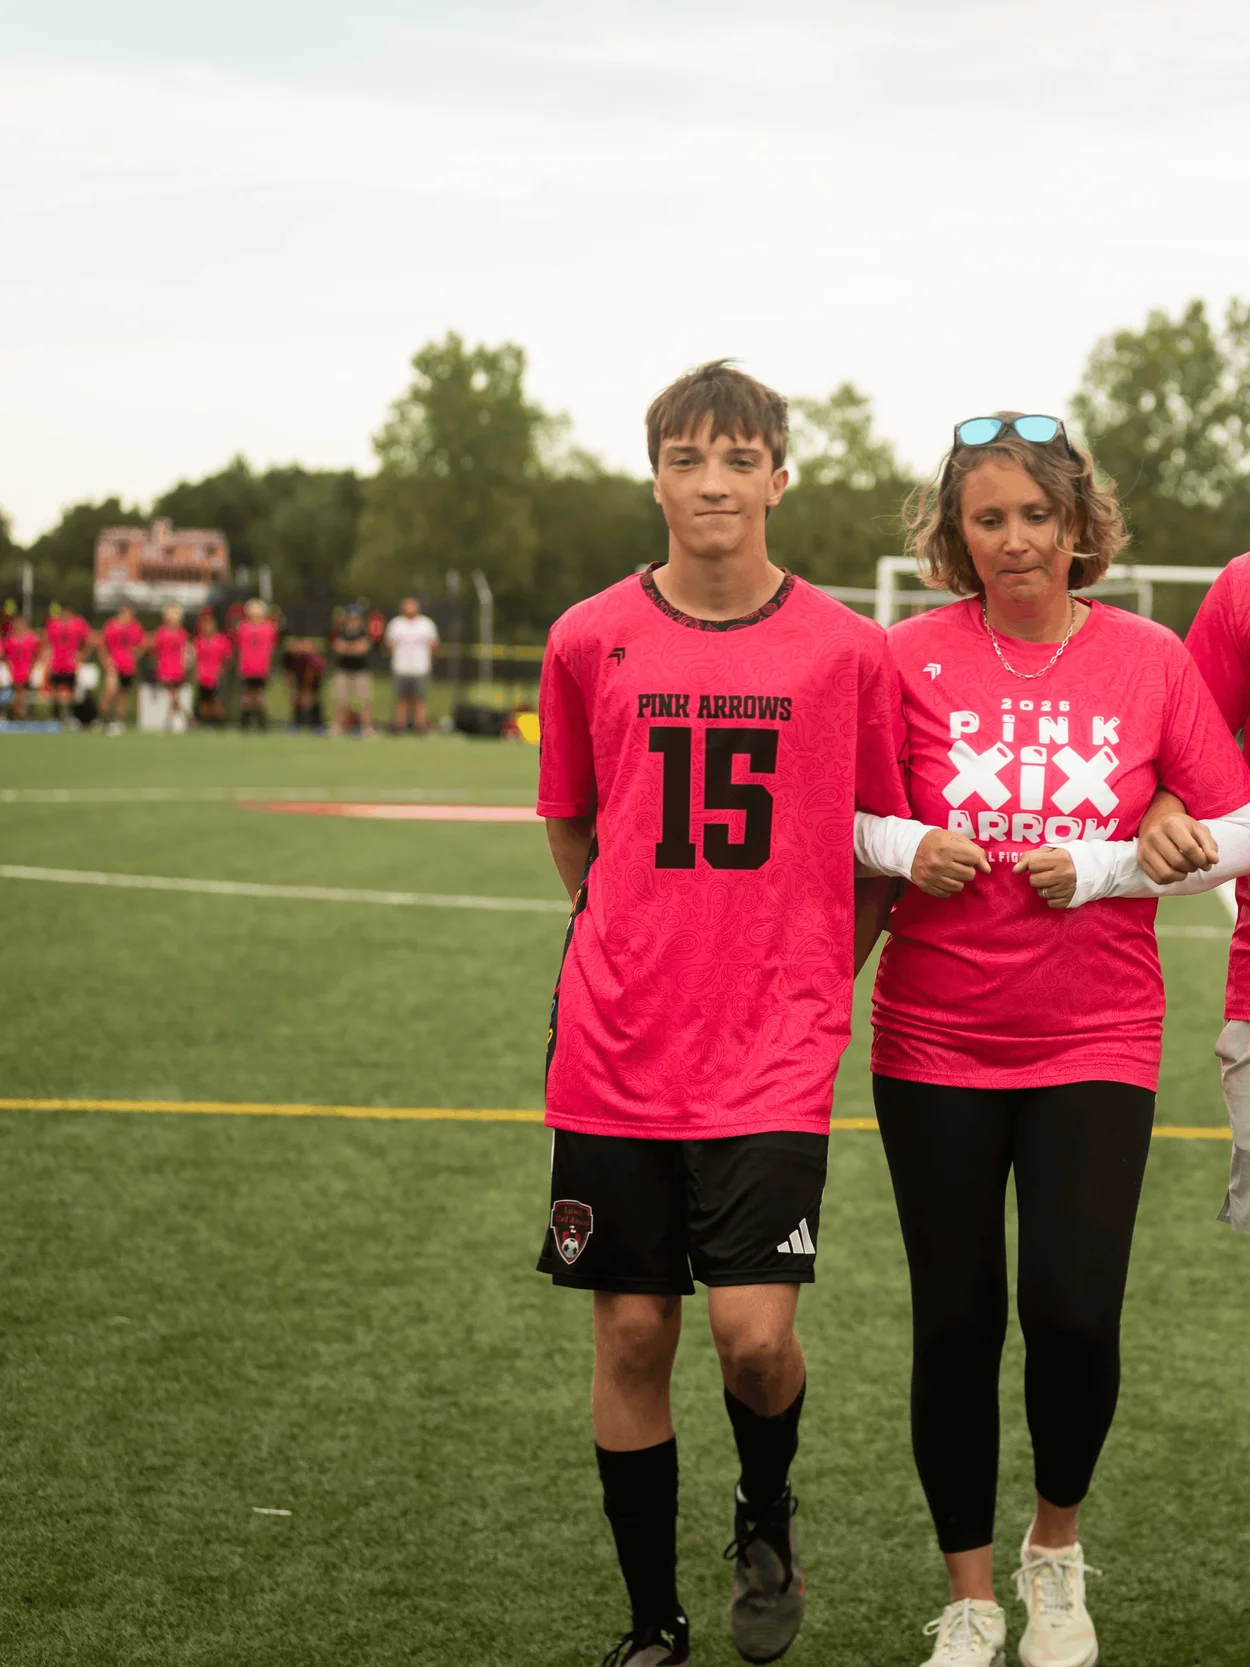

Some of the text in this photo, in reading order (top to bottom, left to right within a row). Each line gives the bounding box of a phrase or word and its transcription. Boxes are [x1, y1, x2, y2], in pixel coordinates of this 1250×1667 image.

[637, 693, 793, 722] PINK ARROWS
[1000, 698, 1070, 712] 2026
[648, 726, 779, 871] 15
[947, 809, 1121, 844] ARROW
